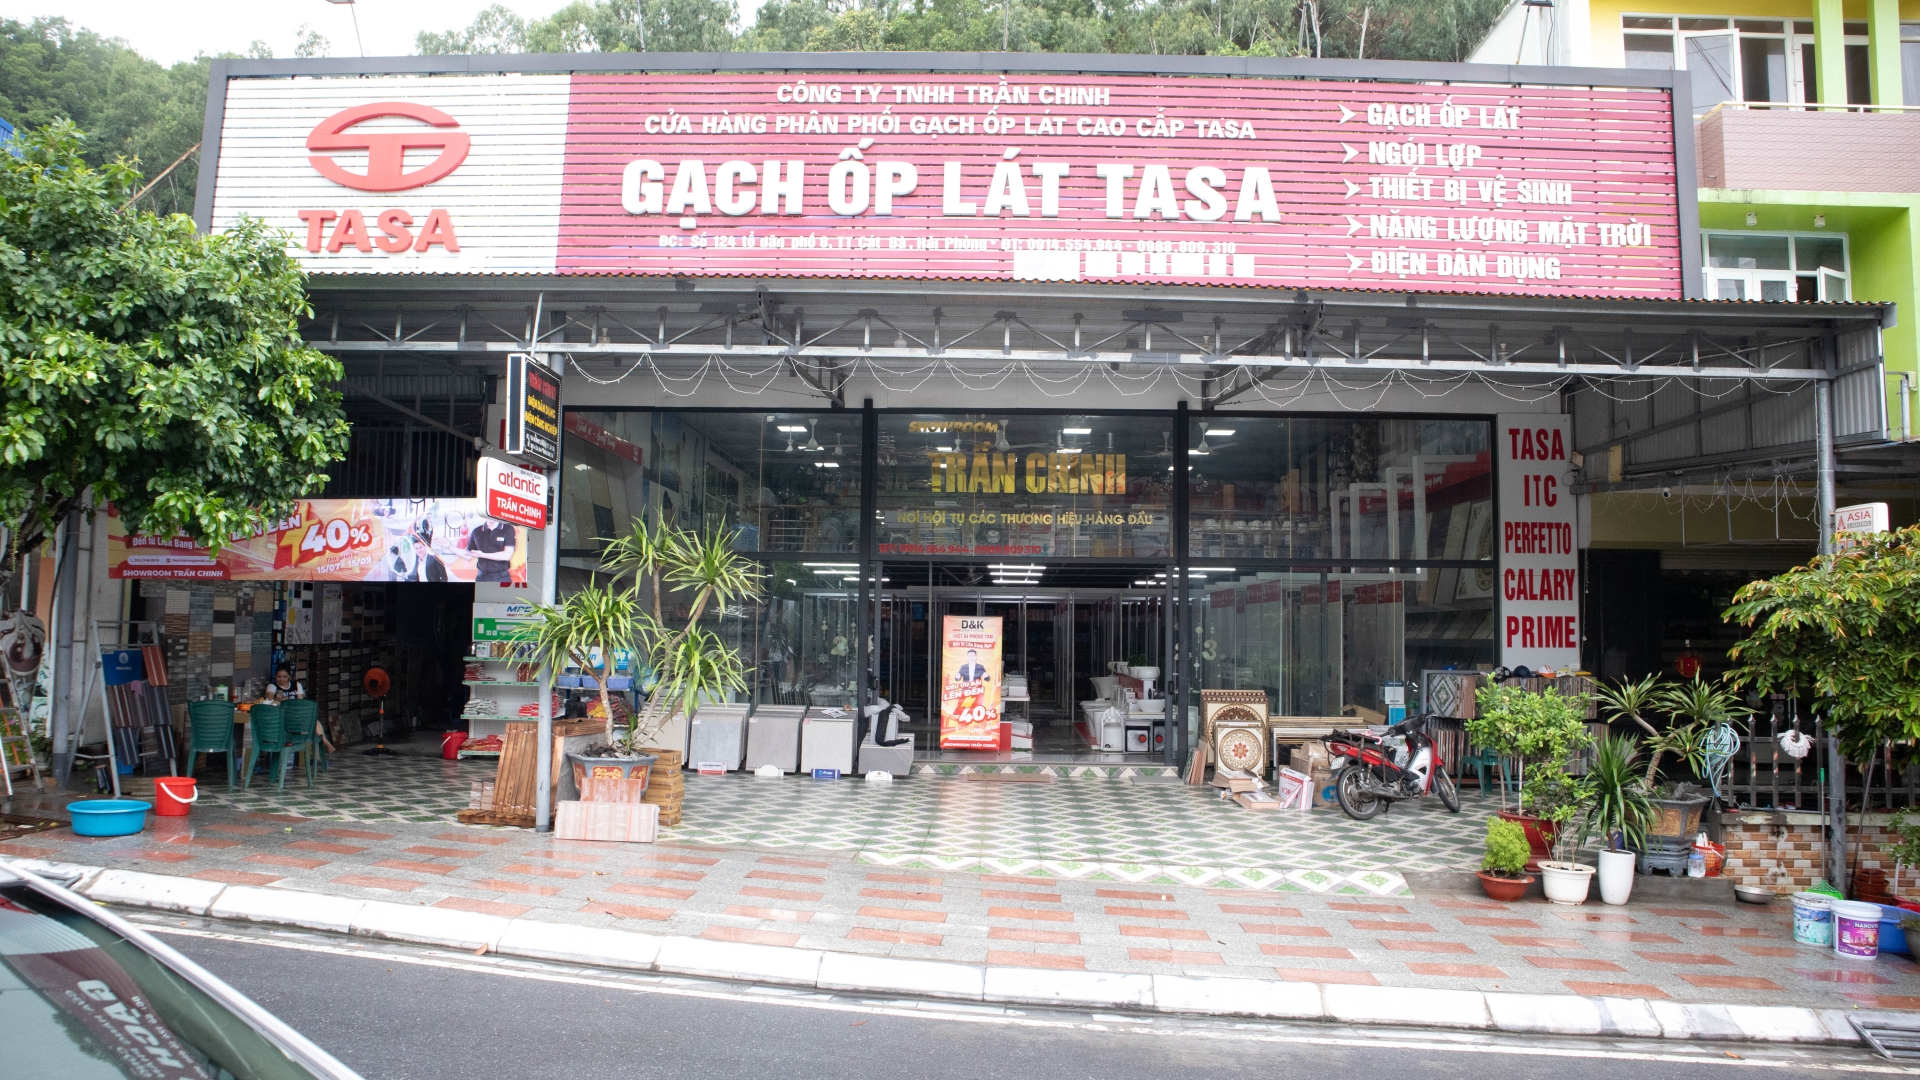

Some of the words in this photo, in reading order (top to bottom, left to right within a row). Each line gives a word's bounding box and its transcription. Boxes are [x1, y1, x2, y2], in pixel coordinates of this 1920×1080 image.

[776, 80, 842, 104] CÔNG
[851, 85, 882, 103] TY
[892, 85, 955, 104] TNHH
[963, 75, 1029, 104] TRẦN
[1038, 86, 1110, 106] CHINH
[644, 108, 693, 134] CỬA
[702, 110, 767, 134] HÀNG
[775, 110, 839, 134] PHÂN
[848, 105, 900, 134] PHỐI
[909, 116, 975, 139] GẠCH
[983, 105, 1016, 135] ỐP
[1024, 109, 1067, 136] LÁT
[1076, 117, 1127, 137] CAO
[1136, 107, 1185, 138] CẤP
[1194, 119, 1257, 139] TASA
[1367, 103, 1431, 131] GẠCH
[1440, 97, 1471, 128] ỐP
[1480, 100, 1520, 130] LÁT
[1367, 137, 1426, 166] NGÓI
[1435, 142, 1482, 172] LỢP
[621, 159, 805, 230] GẠCH
[828, 138, 919, 216] ỐP
[943, 148, 1070, 218] LÁT
[1096, 163, 1282, 222] TASA
[1369, 167, 1434, 202] THIẾT
[1444, 179, 1467, 206] BỊ
[1478, 174, 1507, 208] VỆ
[1517, 181, 1573, 206] SINH
[297, 209, 461, 253] TASA
[691, 231, 708, 248] Số
[713, 236, 736, 248] 124
[741, 231, 756, 248] tổ
[760, 234, 785, 248] dân
[791, 232, 816, 249] phố
[837, 236, 852, 249] TT
[858, 235, 881, 249] Cát
[945, 236, 988, 251] Phòng
[1370, 209, 1437, 240] NĂNG
[1448, 216, 1528, 246] LƯỢNG
[1538, 216, 1589, 249] MẶT
[1597, 218, 1651, 247] TRỜI
[1371, 246, 1427, 279] ĐIỆN
[1437, 248, 1487, 278] DÂN
[1497, 255, 1561, 284] DỤNG
[908, 421, 999, 434] SHOWROOM
[1508, 428, 1566, 461] TASA
[498, 471, 541, 496] atlantic
[926, 441, 1016, 494] TRẤN
[1025, 452, 1127, 495] CHINH
[1523, 474, 1558, 508] ITC
[496, 496, 517, 514] TRẤN
[518, 502, 542, 520] CHINH
[950, 513, 965, 526] TỤ
[969, 510, 997, 525] CÁC
[1000, 513, 1053, 525] THƯƠNG
[1086, 511, 1125, 526] HÀNG
[1127, 511, 1153, 526] ĐẦU
[1847, 510, 1872, 522] ASIA
[174, 538, 193, 549] Bang
[301, 519, 371, 554] 40%
[1504, 521, 1572, 555] PERFETTO
[316, 561, 341, 574] 15/07
[348, 556, 372, 568] 15/09
[1504, 568, 1576, 601] CALARY
[961, 619, 985, 630] D&K
[1506, 616, 1577, 648] PRIME
[943, 688, 962, 701] LÊN
[959, 705, 997, 723] 40%
